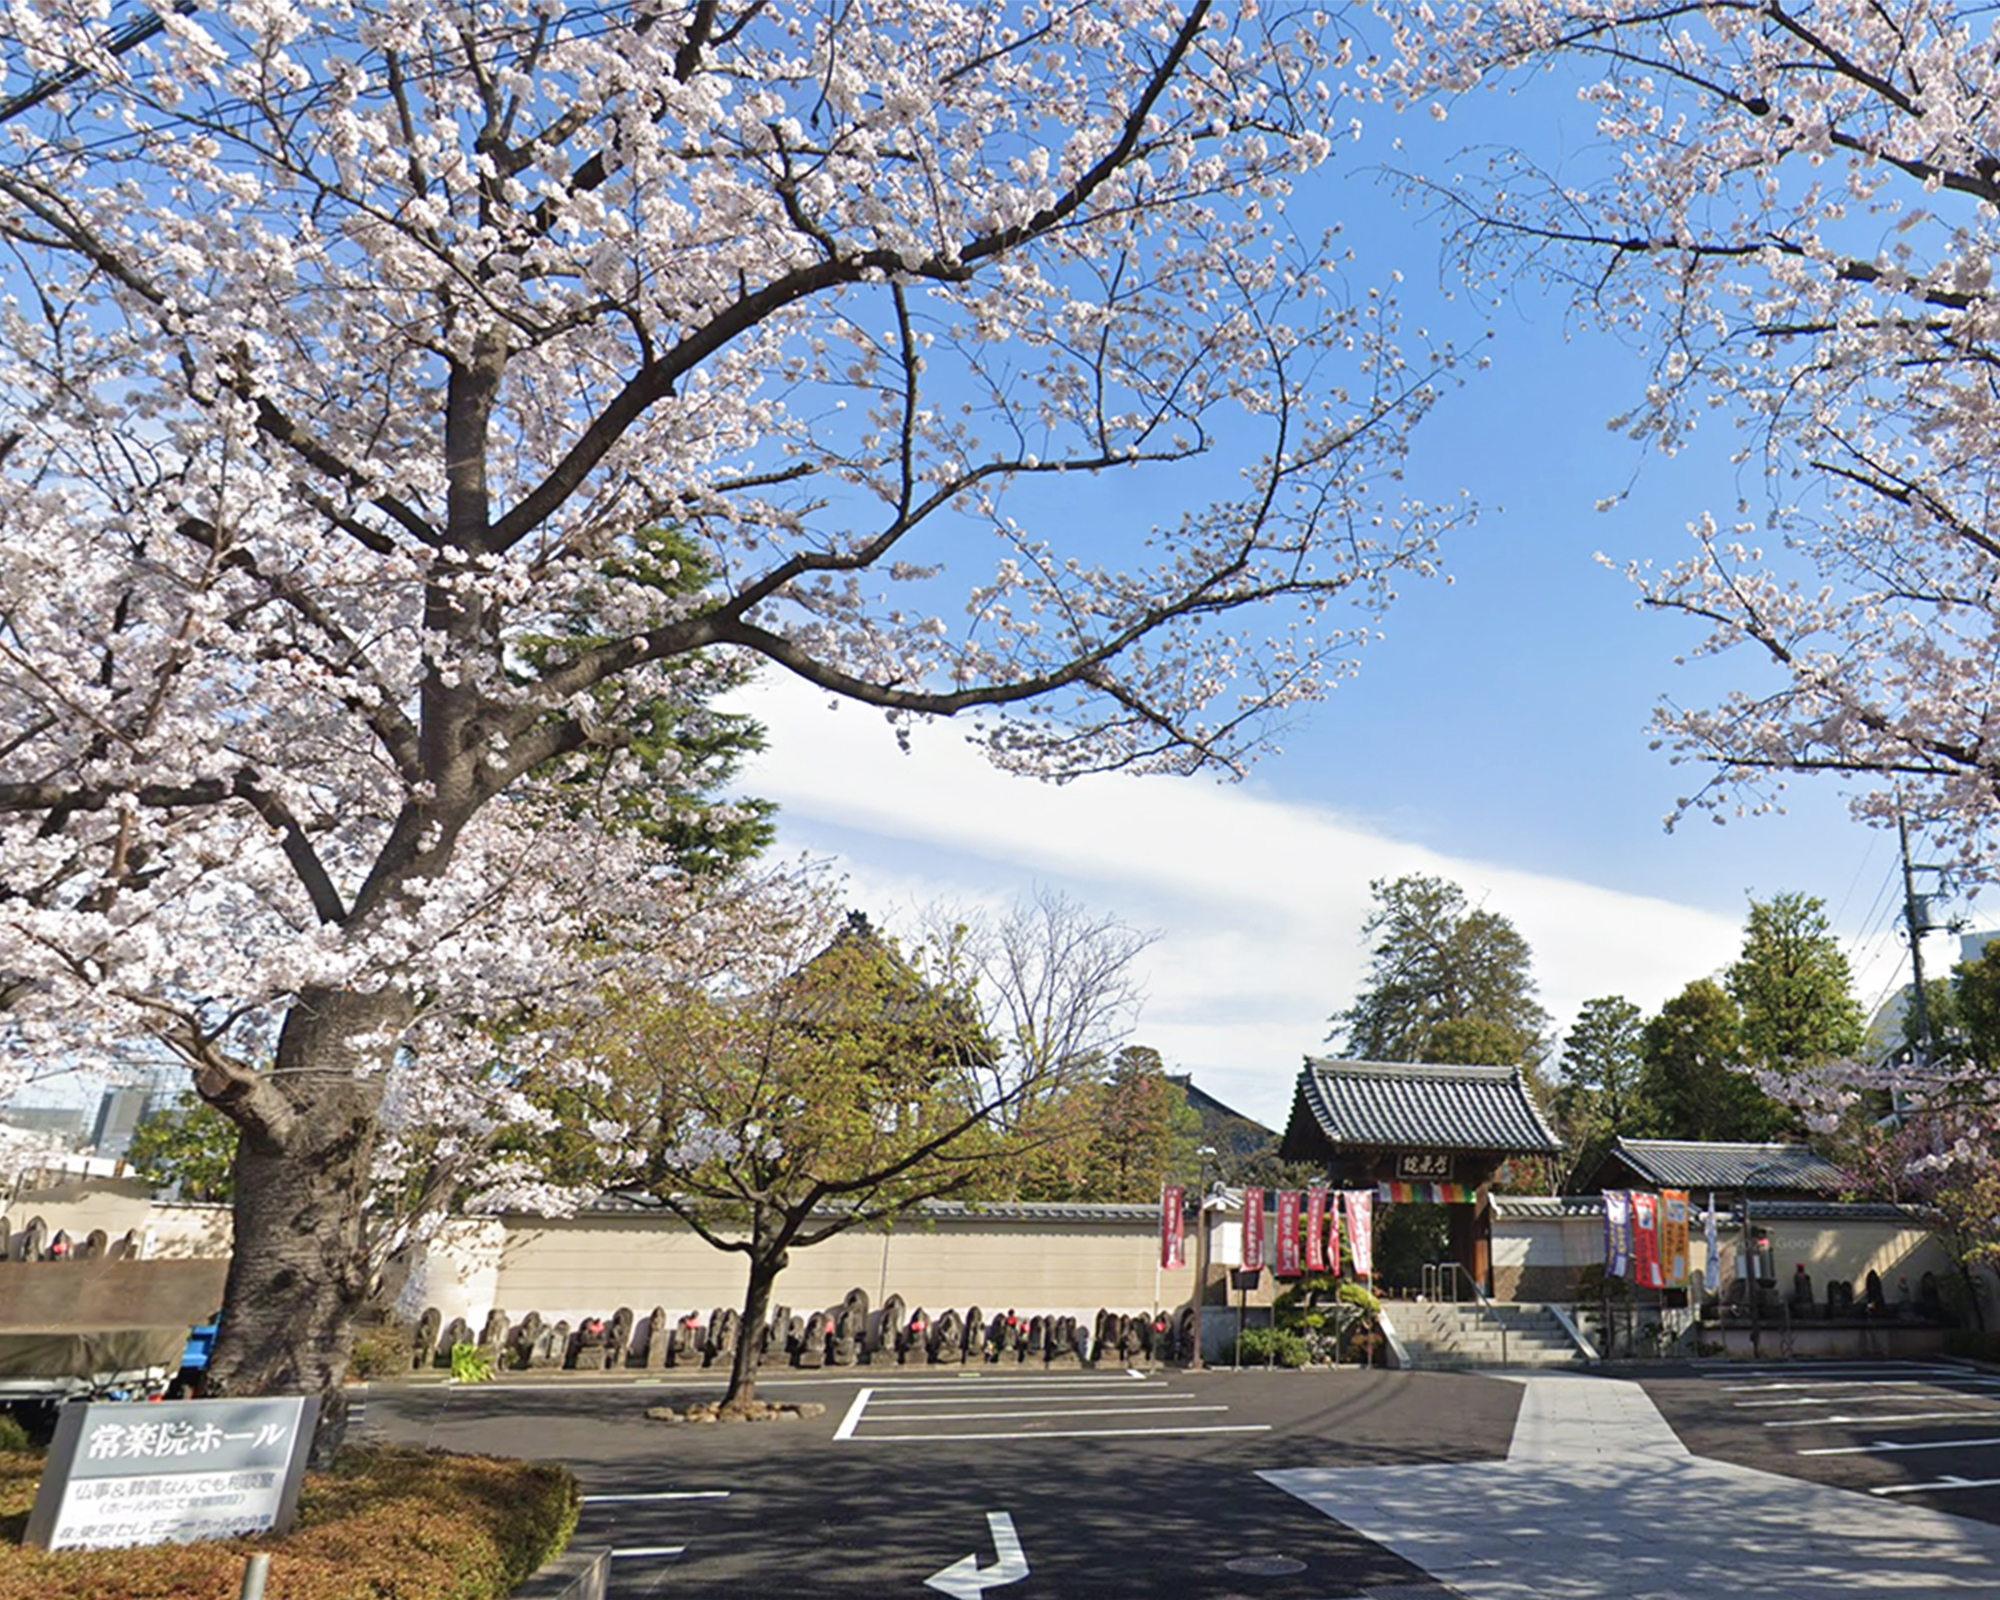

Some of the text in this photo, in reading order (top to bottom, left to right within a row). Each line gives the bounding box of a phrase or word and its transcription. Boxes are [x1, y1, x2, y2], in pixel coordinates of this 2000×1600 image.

[89, 1422, 286, 1459] 常楽院ホール
